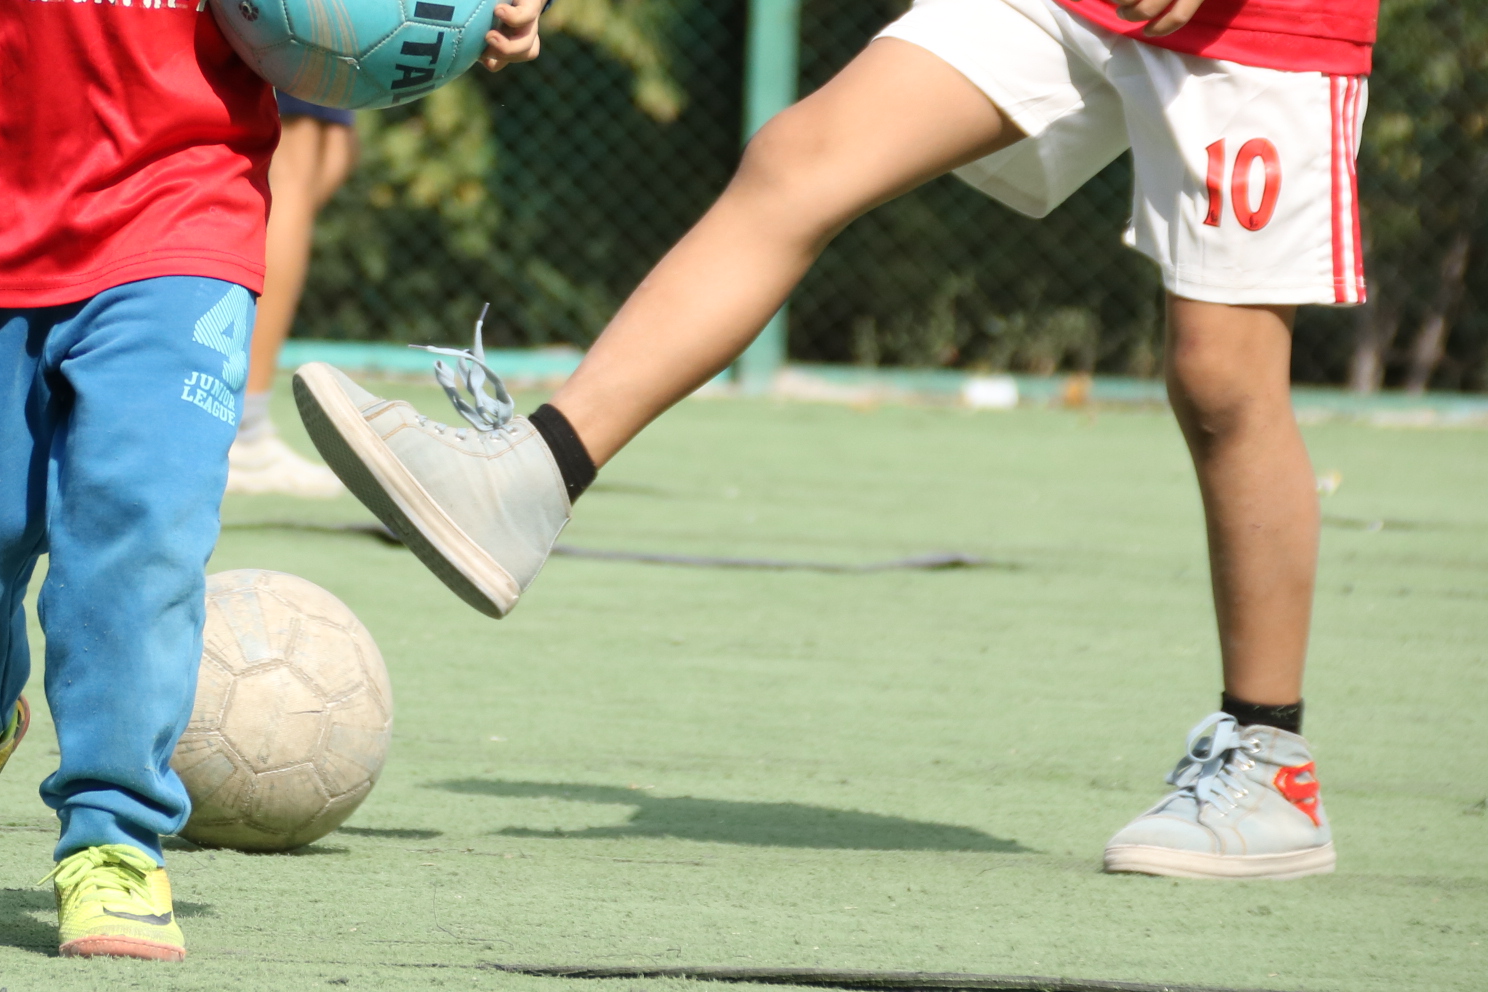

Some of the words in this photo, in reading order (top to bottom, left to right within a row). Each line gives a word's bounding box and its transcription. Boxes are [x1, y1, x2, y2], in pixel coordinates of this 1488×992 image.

[1202, 137, 1282, 232] 10
[181, 385, 236, 426] LEAGUE
[184, 371, 235, 412] JUNIOR
